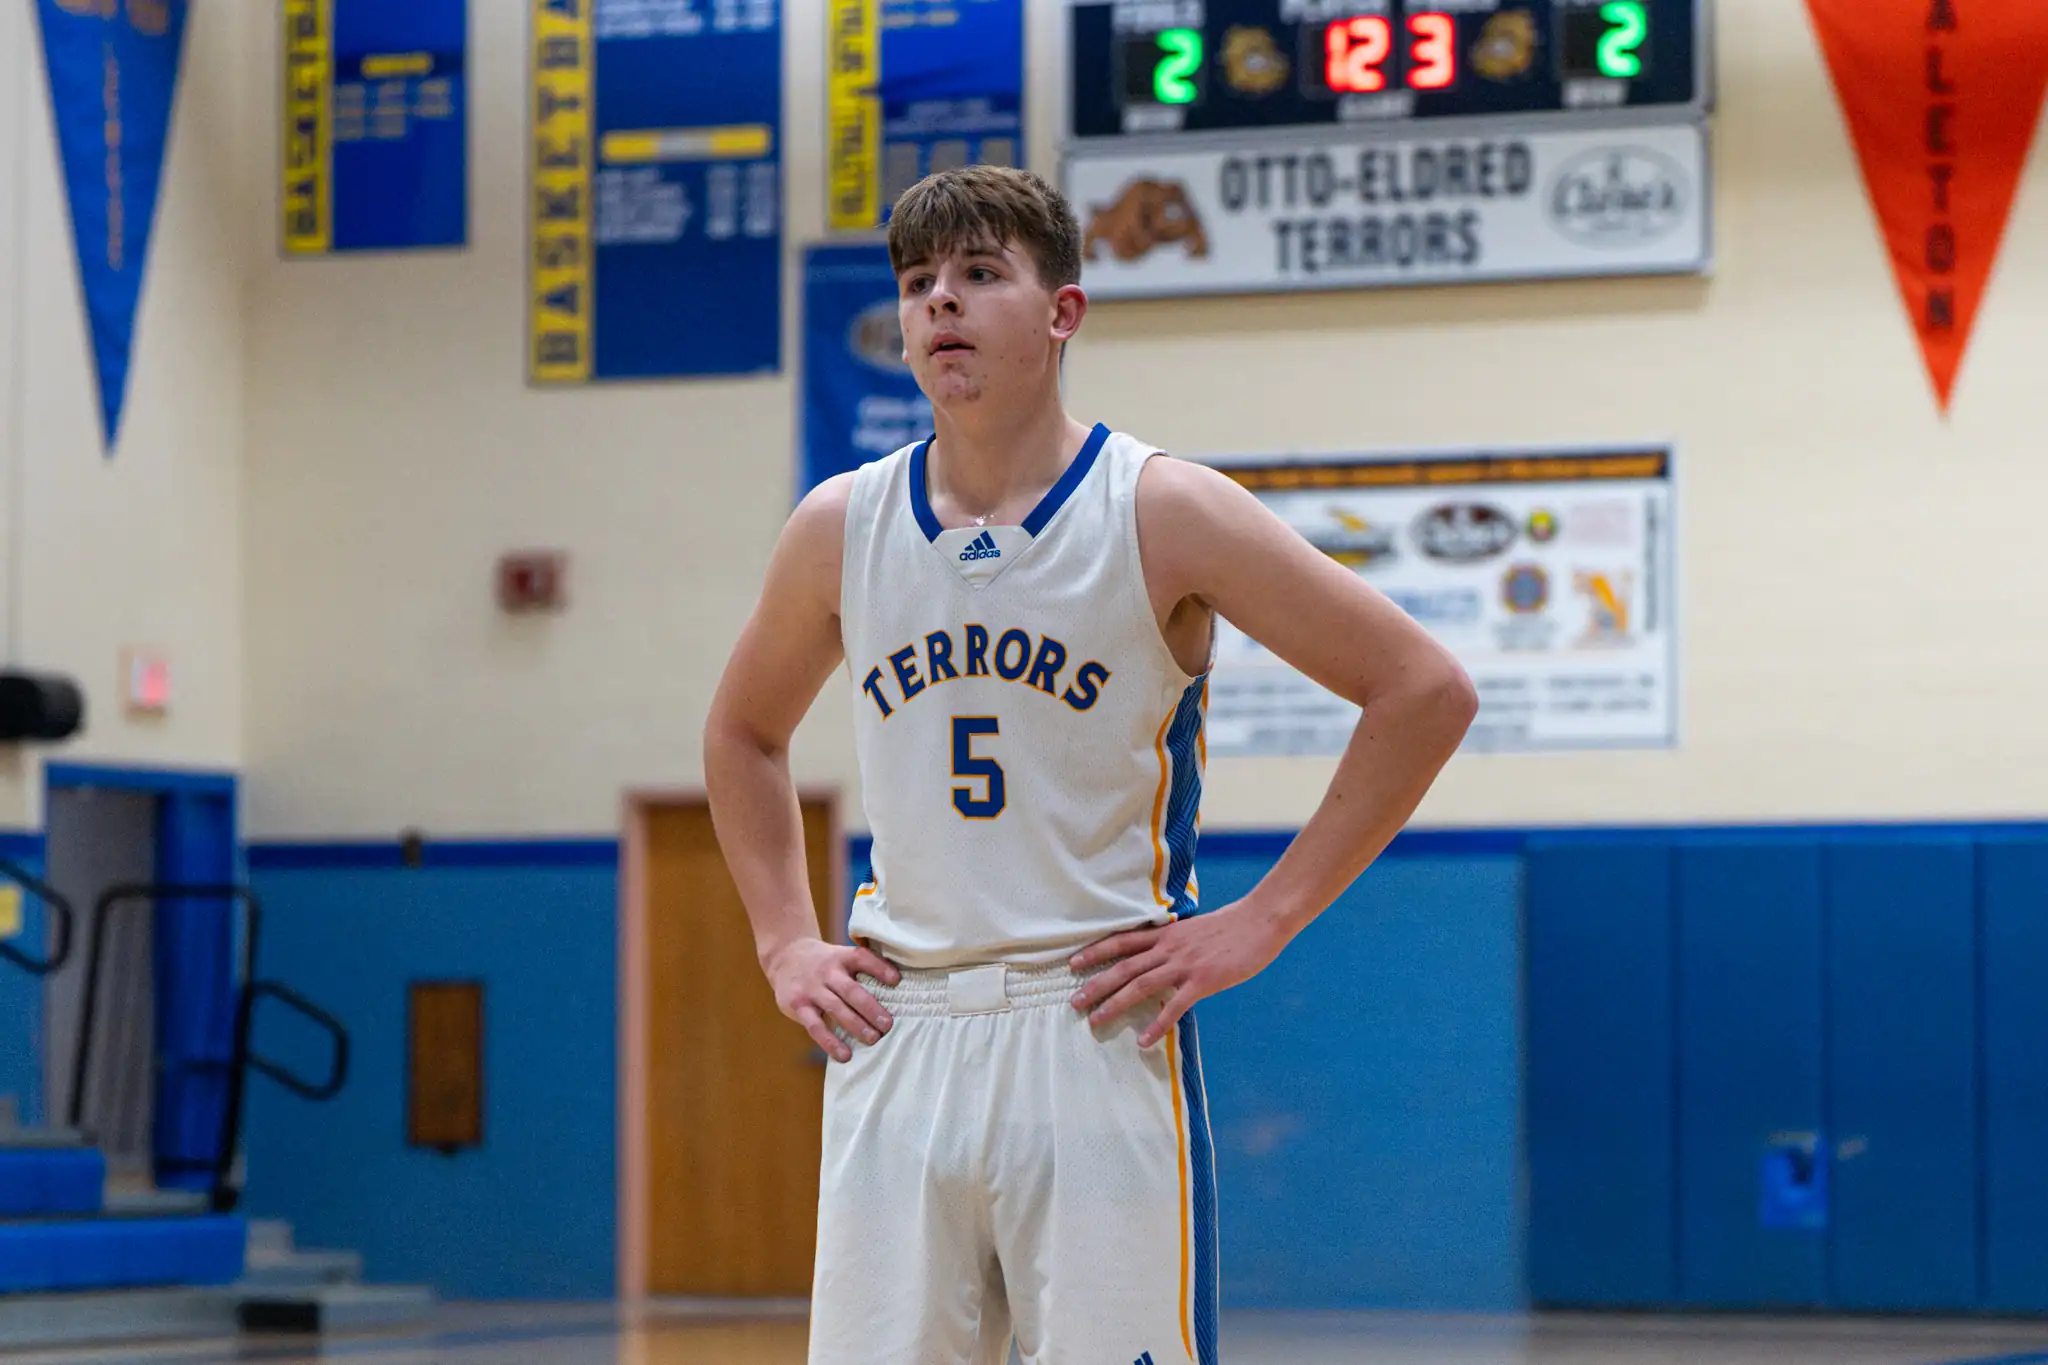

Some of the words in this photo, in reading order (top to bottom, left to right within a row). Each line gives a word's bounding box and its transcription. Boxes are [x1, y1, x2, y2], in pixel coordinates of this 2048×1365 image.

[1153, 28, 1201, 103] 2
[1325, 15, 1391, 92] 12
[1406, 12, 1455, 88] 3
[1597, 0, 1647, 77] 2
[1220, 141, 1532, 212] OTTO-ELDRED
[1273, 208, 1480, 274] TERRORS
[959, 549, 1001, 561] adidas
[862, 622, 1112, 721] TERRORS
[950, 715, 1007, 820] 5
